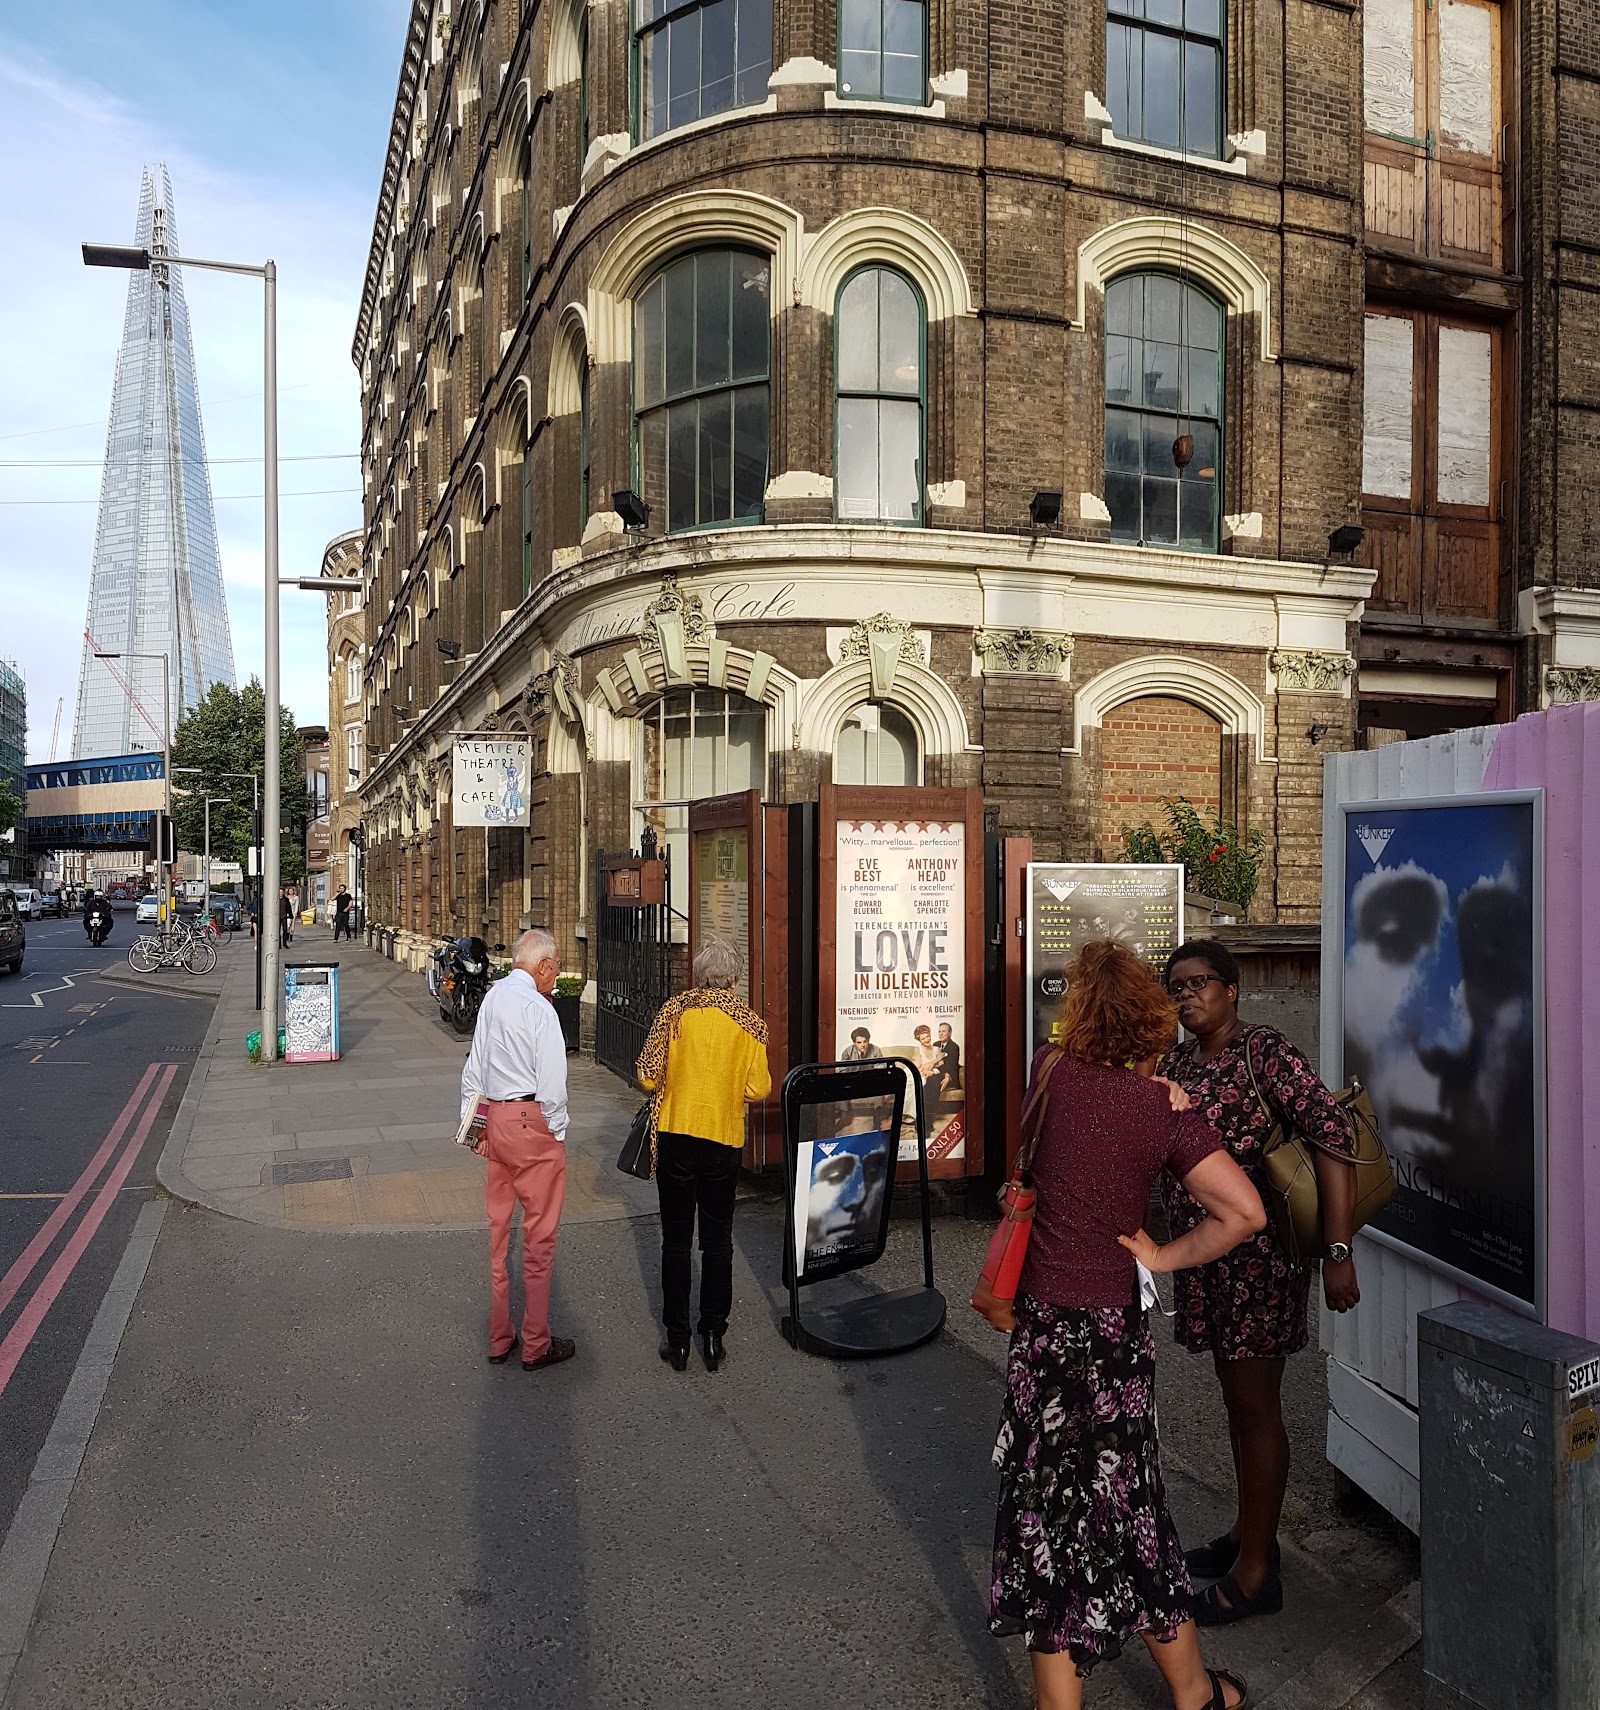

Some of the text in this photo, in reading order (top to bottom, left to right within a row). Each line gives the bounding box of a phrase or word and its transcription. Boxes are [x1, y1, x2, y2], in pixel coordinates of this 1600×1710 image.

[576, 582, 796, 648] Menier Cafe
[459, 743, 524, 756] MENIER
[476, 774, 483, 782] &
[462, 792, 494, 803] CAFE
[1358, 828, 1392, 840] BUNKER
[854, 870, 881, 882] BEST
[918, 870, 946, 882] HEAD
[854, 930, 949, 972] LOVE
[854, 972, 949, 990] IN IDLENESS
[927, 1121, 961, 1159] ONLY 50
[1569, 1360, 1599, 1393] SPIV
